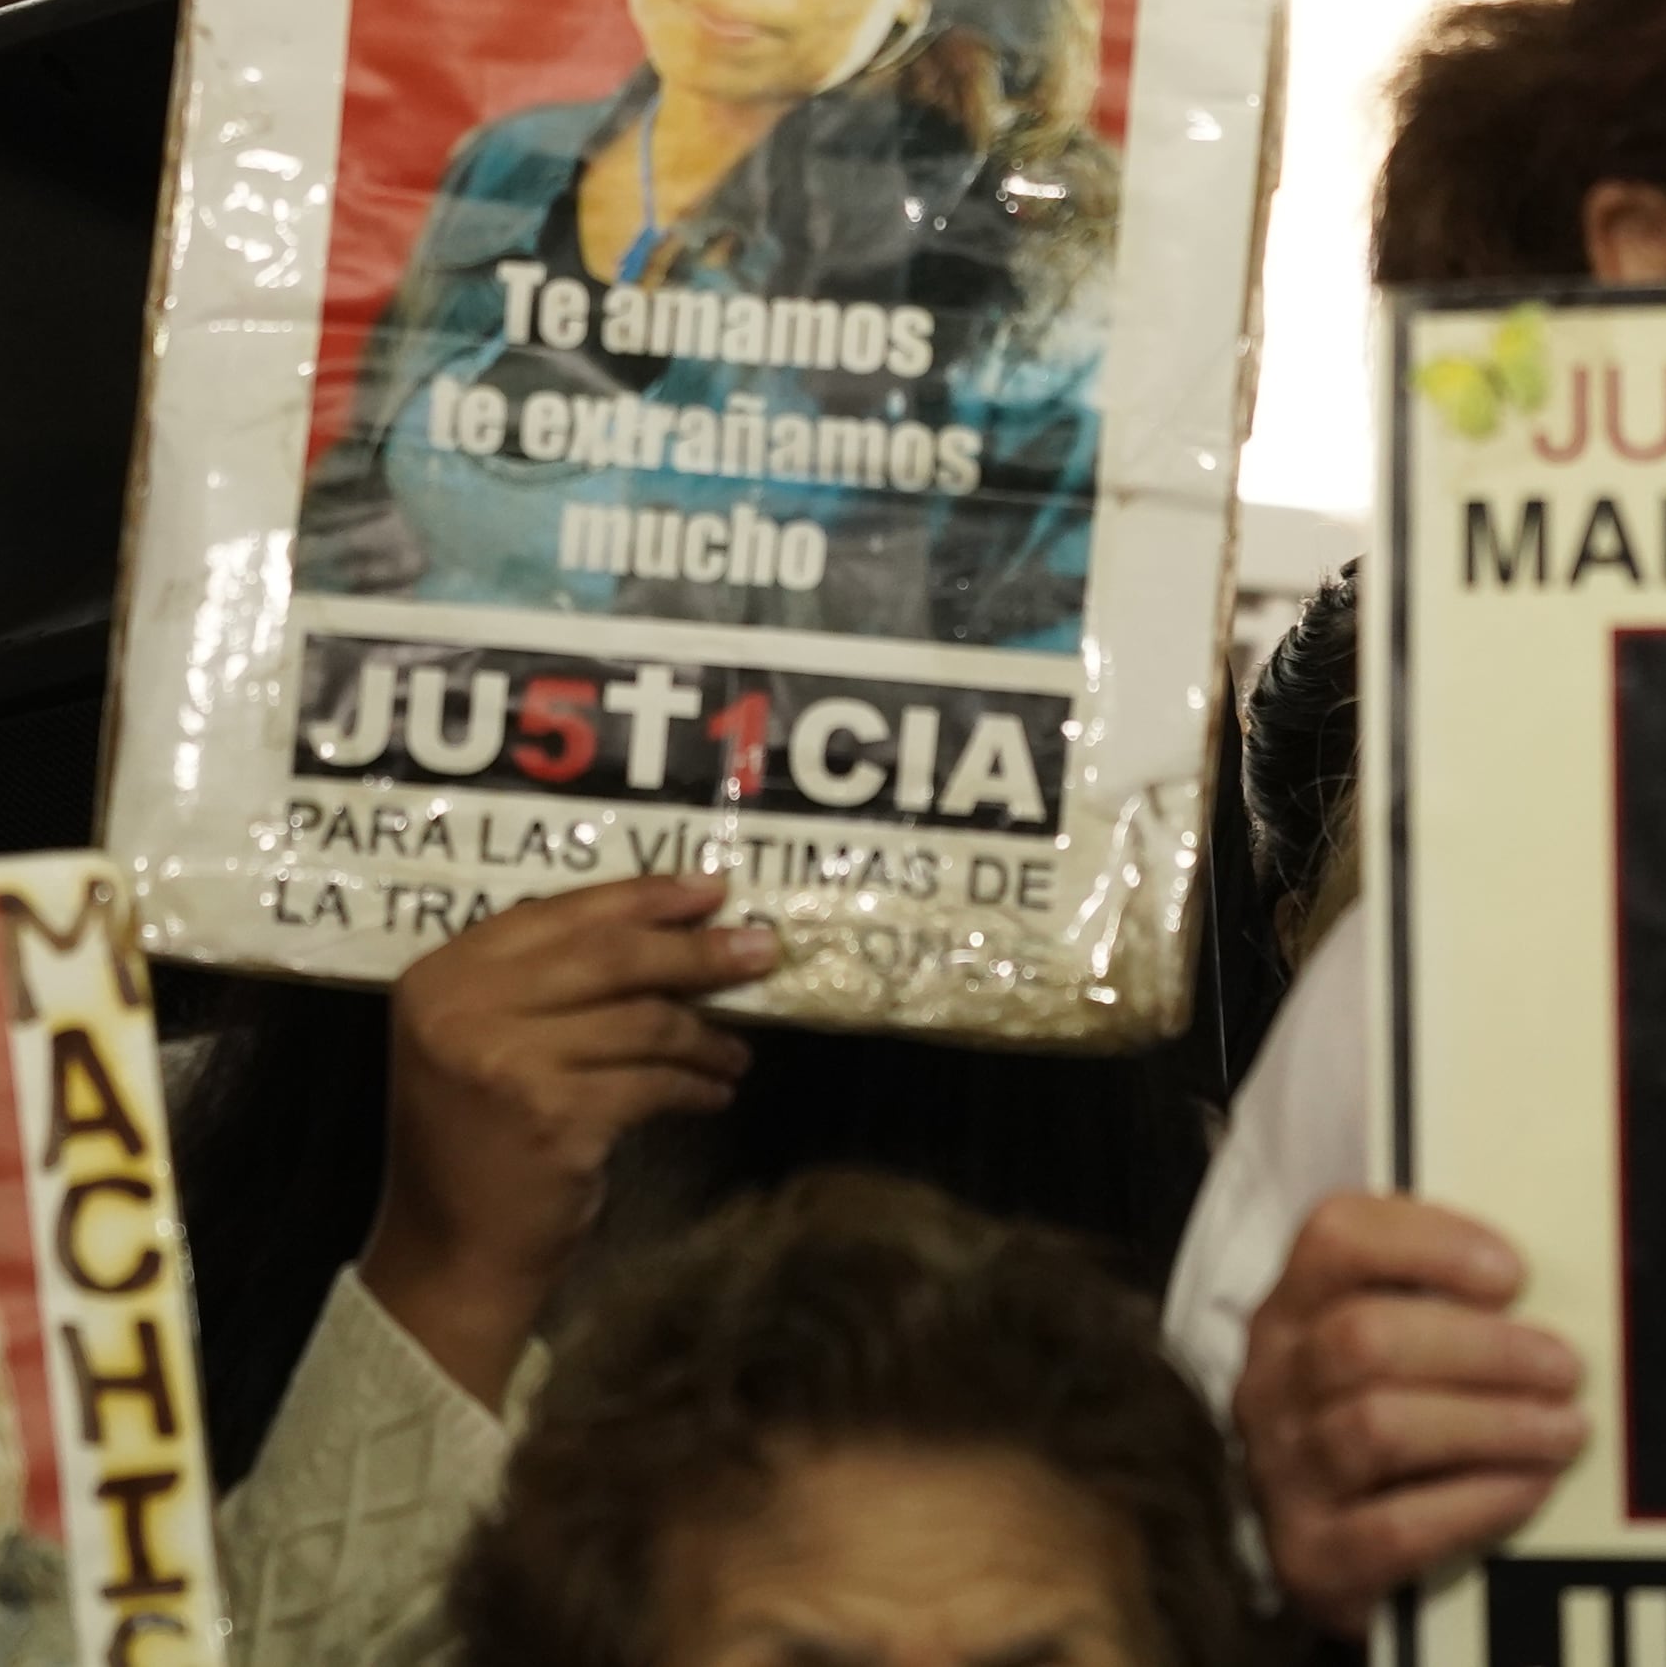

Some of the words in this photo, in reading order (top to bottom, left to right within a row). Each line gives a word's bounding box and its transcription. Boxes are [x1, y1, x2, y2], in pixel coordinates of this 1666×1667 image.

[496, 260, 588, 350] Te
[601, 285, 934, 377] amamos
[428, 376, 508, 455] te
[520, 390, 982, 495] extrañamos
[558, 500, 825, 590] mucho
[273, 879, 351, 929] LA
[285, 801, 453, 859] PARA
[478, 812, 598, 871] LAS
[968, 854, 1055, 912] DE
[3, 877, 191, 1667] MACHI
